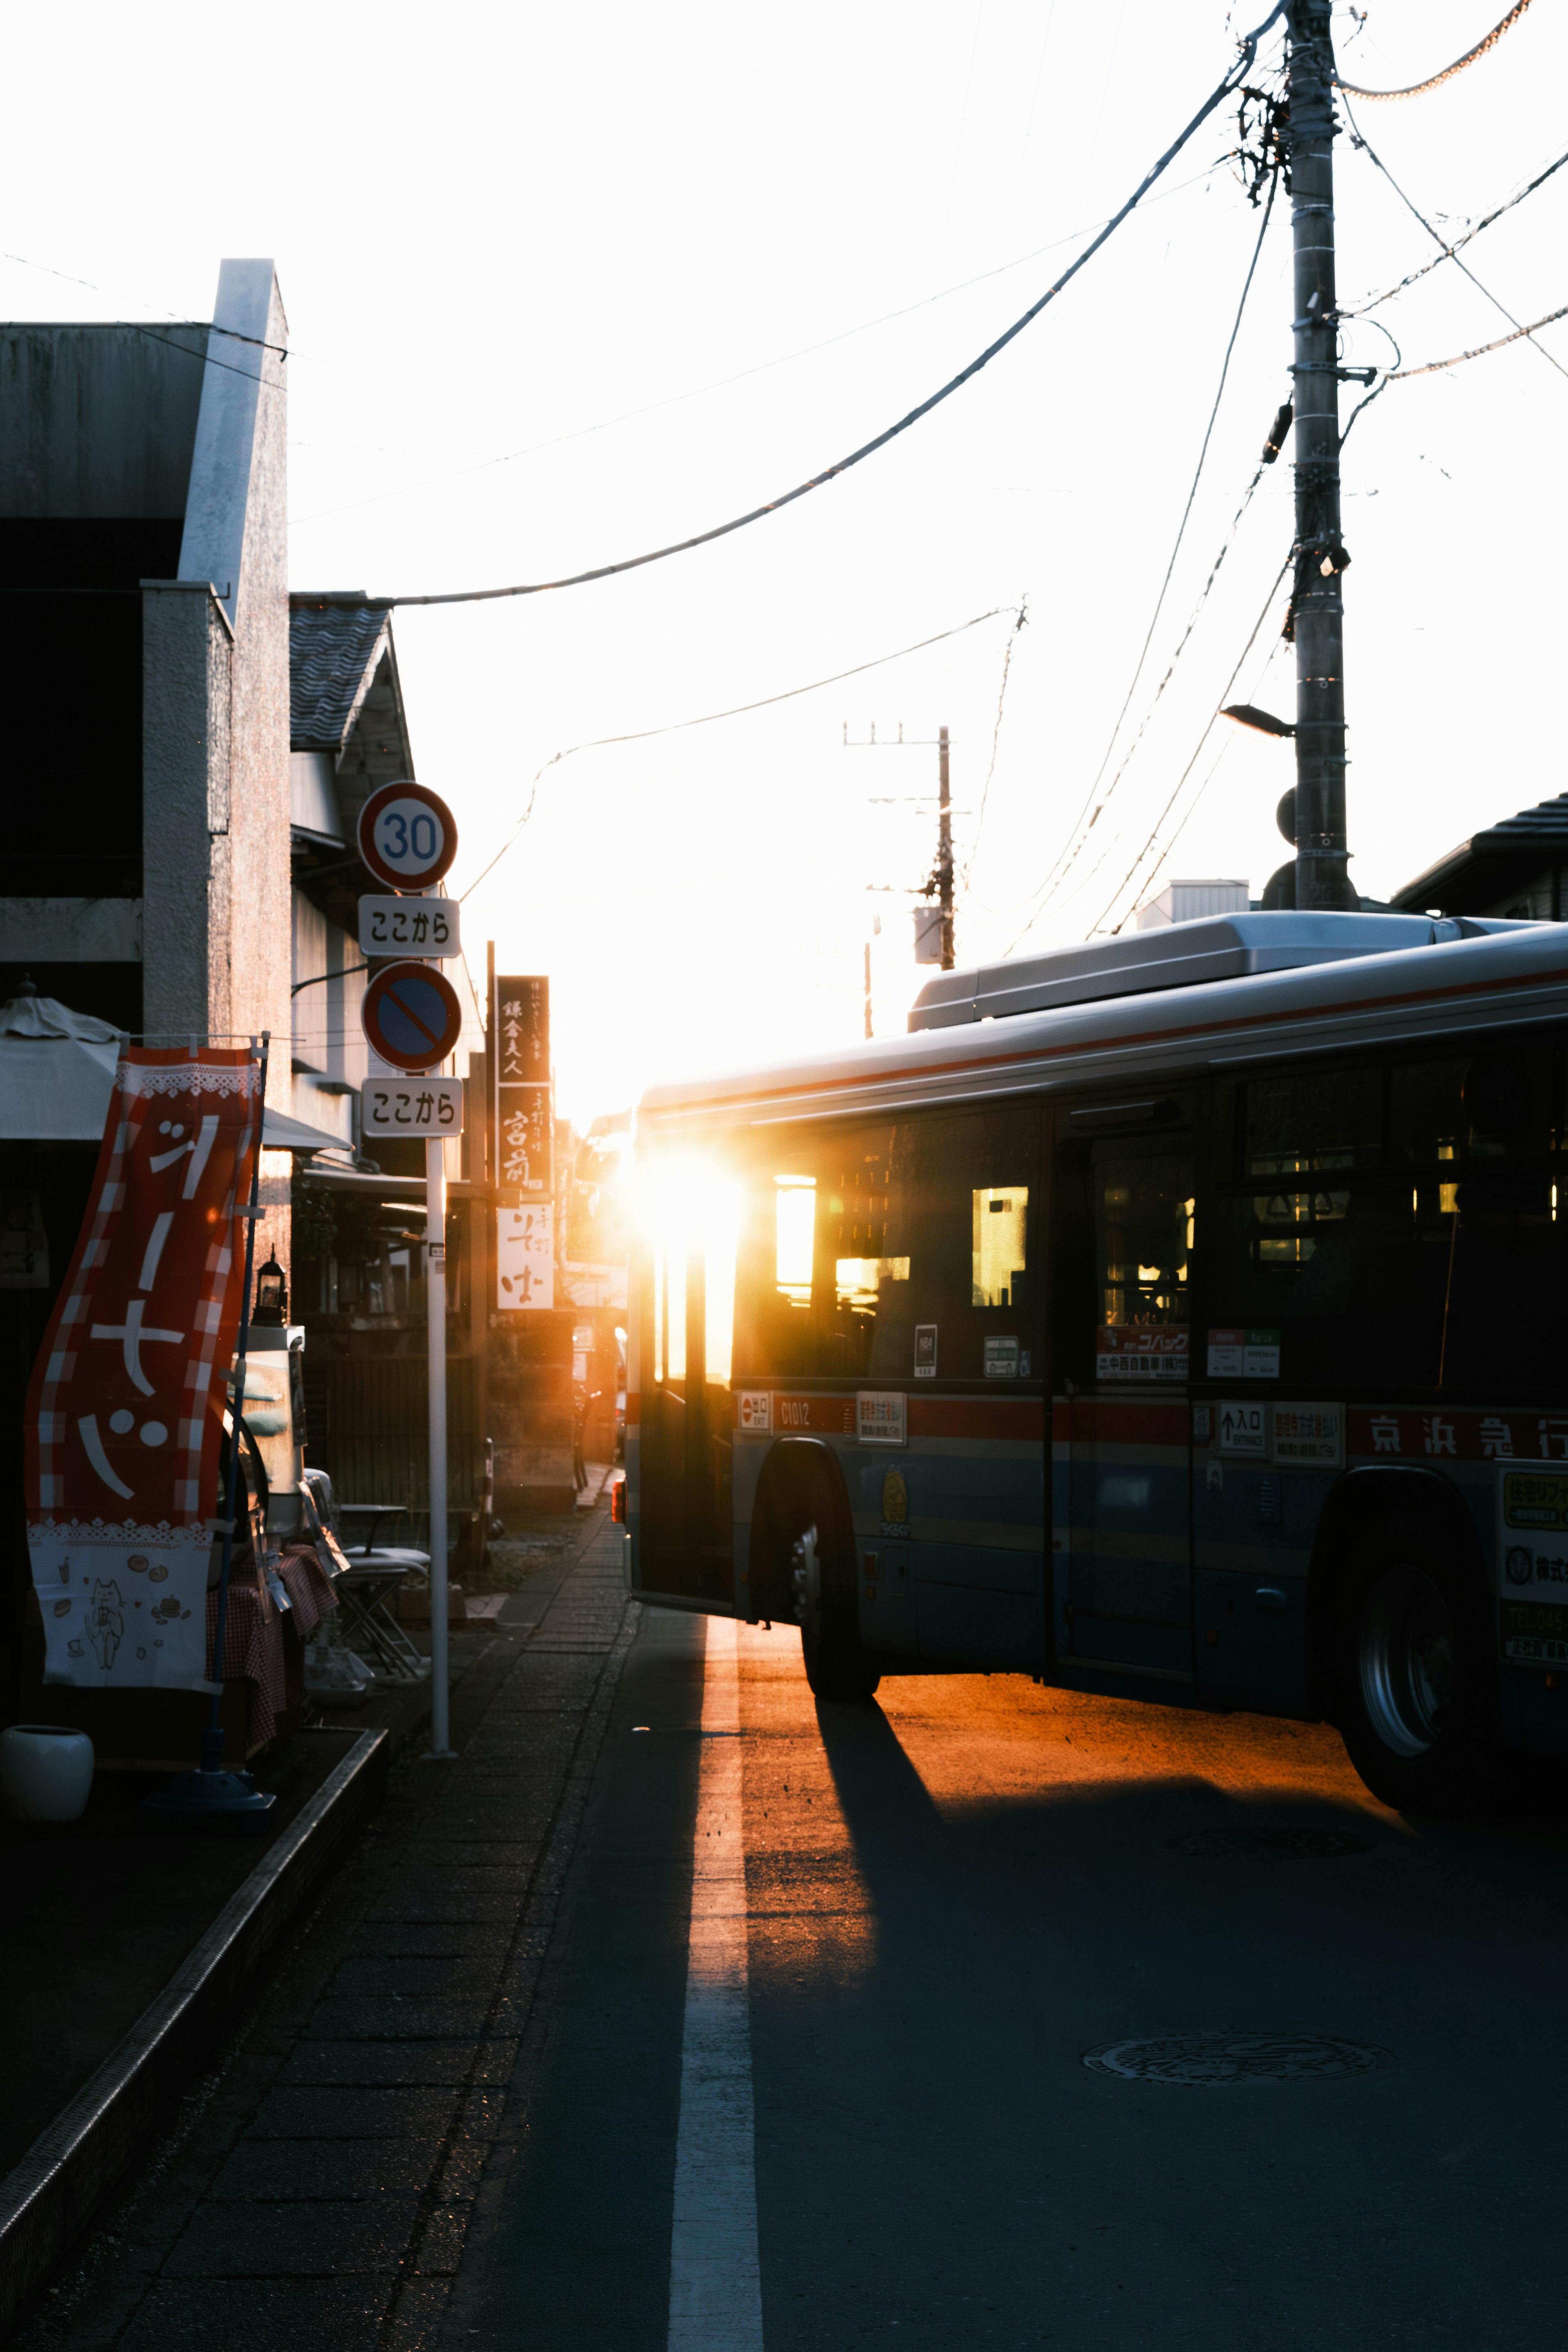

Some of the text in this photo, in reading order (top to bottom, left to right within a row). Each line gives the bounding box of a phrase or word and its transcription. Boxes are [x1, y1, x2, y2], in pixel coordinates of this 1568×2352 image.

[383, 813, 437, 860] 30
[372, 912, 449, 943] ここから
[373, 1092, 454, 1124] ここから
[1237, 1410, 1259, 1430] 入口
[1370, 1414, 1568, 1459] 京浜急行
[1537, 1556, 1568, 1583] 株式
